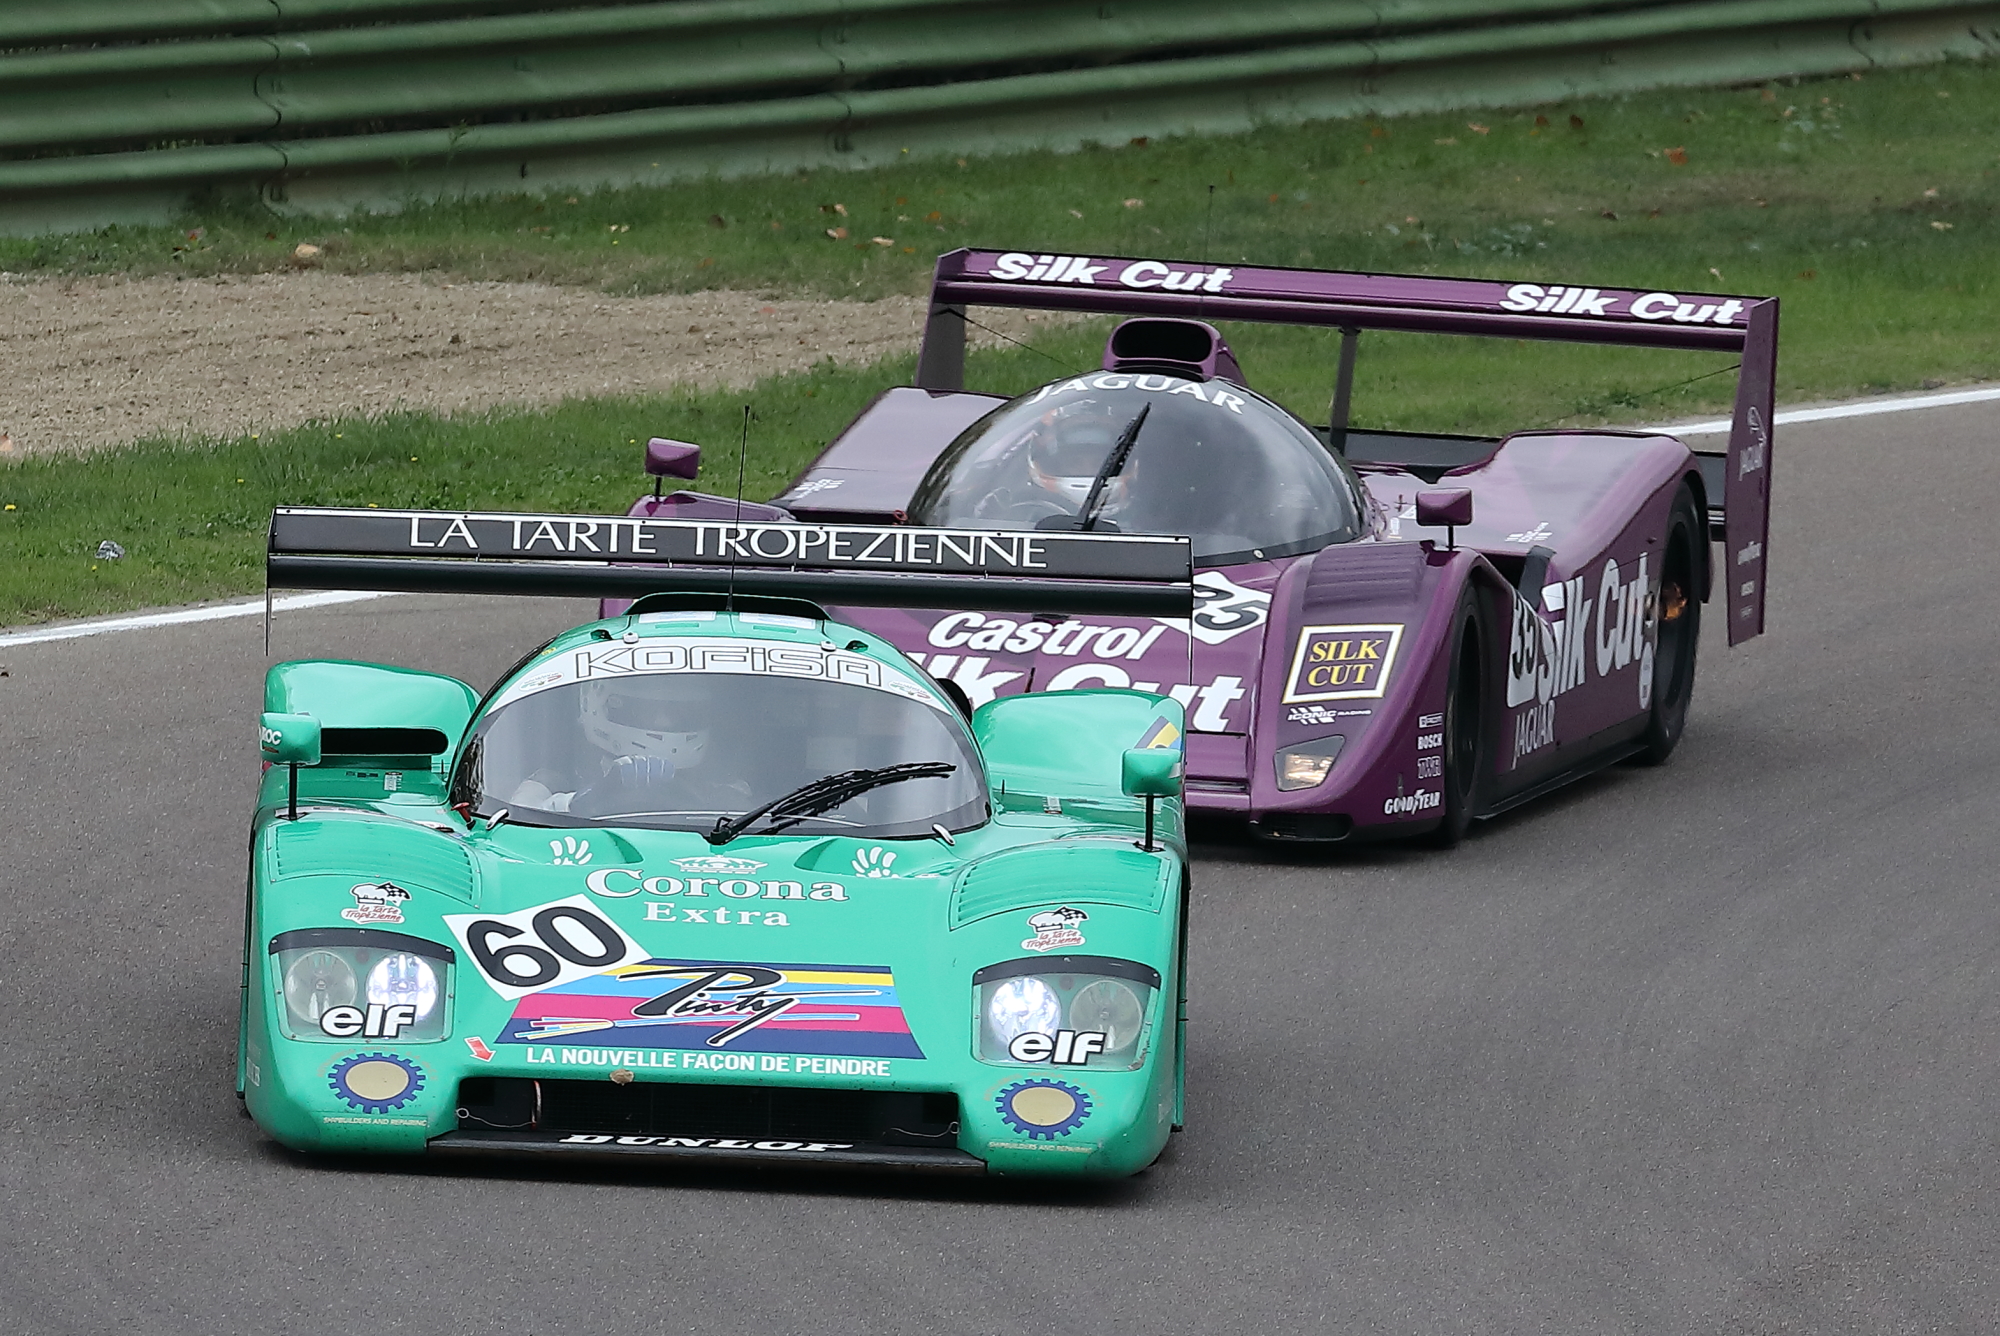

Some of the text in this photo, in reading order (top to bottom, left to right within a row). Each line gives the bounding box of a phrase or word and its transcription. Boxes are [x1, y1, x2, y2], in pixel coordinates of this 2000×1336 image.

[989, 252, 1233, 292] Silk Cut
[1499, 284, 1744, 324] Silk Cut
[1026, 373, 1246, 414] JAGUAR
[410, 517, 1047, 568] LA TARTE TROPEZIENNE
[927, 611, 1168, 660] Castrol
[1537, 575, 1593, 705] Silk
[1596, 552, 1648, 676] Cut
[1309, 639, 1384, 663] SILK
[1307, 663, 1374, 687] CUT
[1287, 710, 1337, 720] ICONIC
[1511, 699, 1556, 770] JAGUAR
[585, 867, 850, 902] Corona
[642, 901, 790, 926] Extra
[466, 906, 627, 987] 60
[320, 1003, 416, 1038] elf
[526, 1047, 891, 1077] LA NOUVELLE FAÇON DE PEINDRE
[1009, 1029, 1106, 1065] elf
[559, 1134, 853, 1152] DUNLOP
